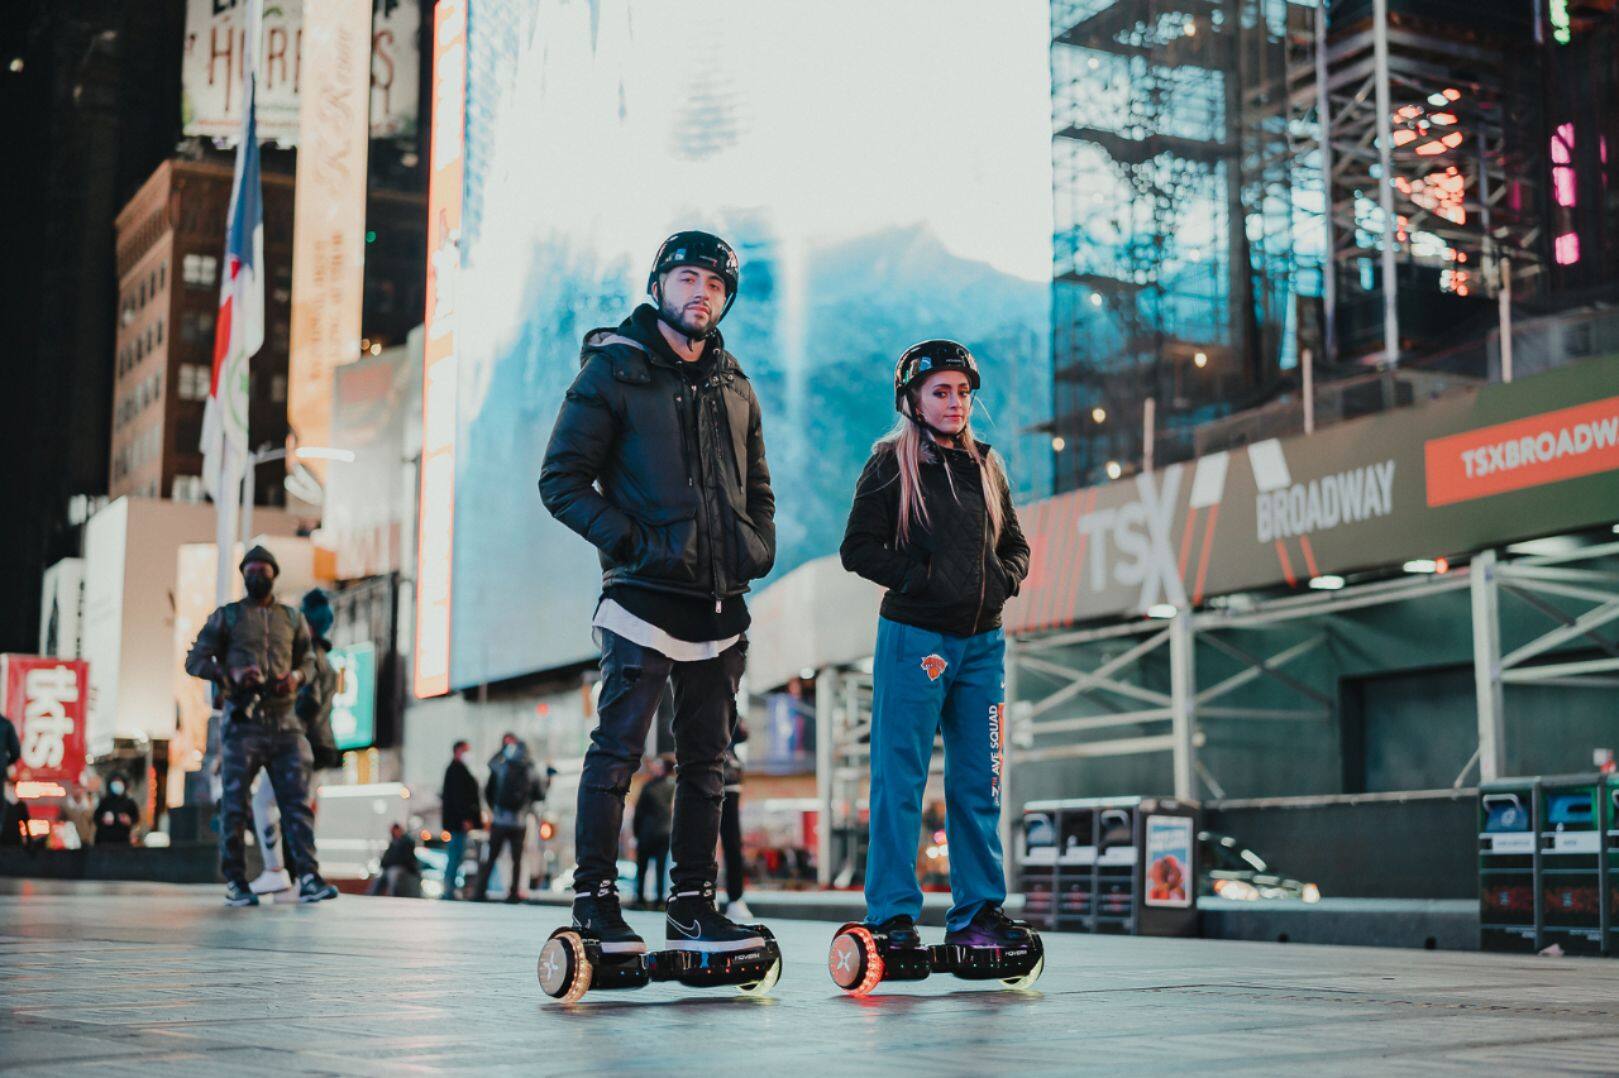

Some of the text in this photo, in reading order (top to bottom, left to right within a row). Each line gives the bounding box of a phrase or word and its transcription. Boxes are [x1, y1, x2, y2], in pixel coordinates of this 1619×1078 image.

[1461, 415, 1619, 479] TSXBROADW
[1077, 462, 1188, 614] TSX
[1255, 459, 1397, 543] BROADWAY
[21, 665, 79, 770] tkts
[988, 705, 1000, 749] SQUAD
[990, 752, 1000, 775] AVE
